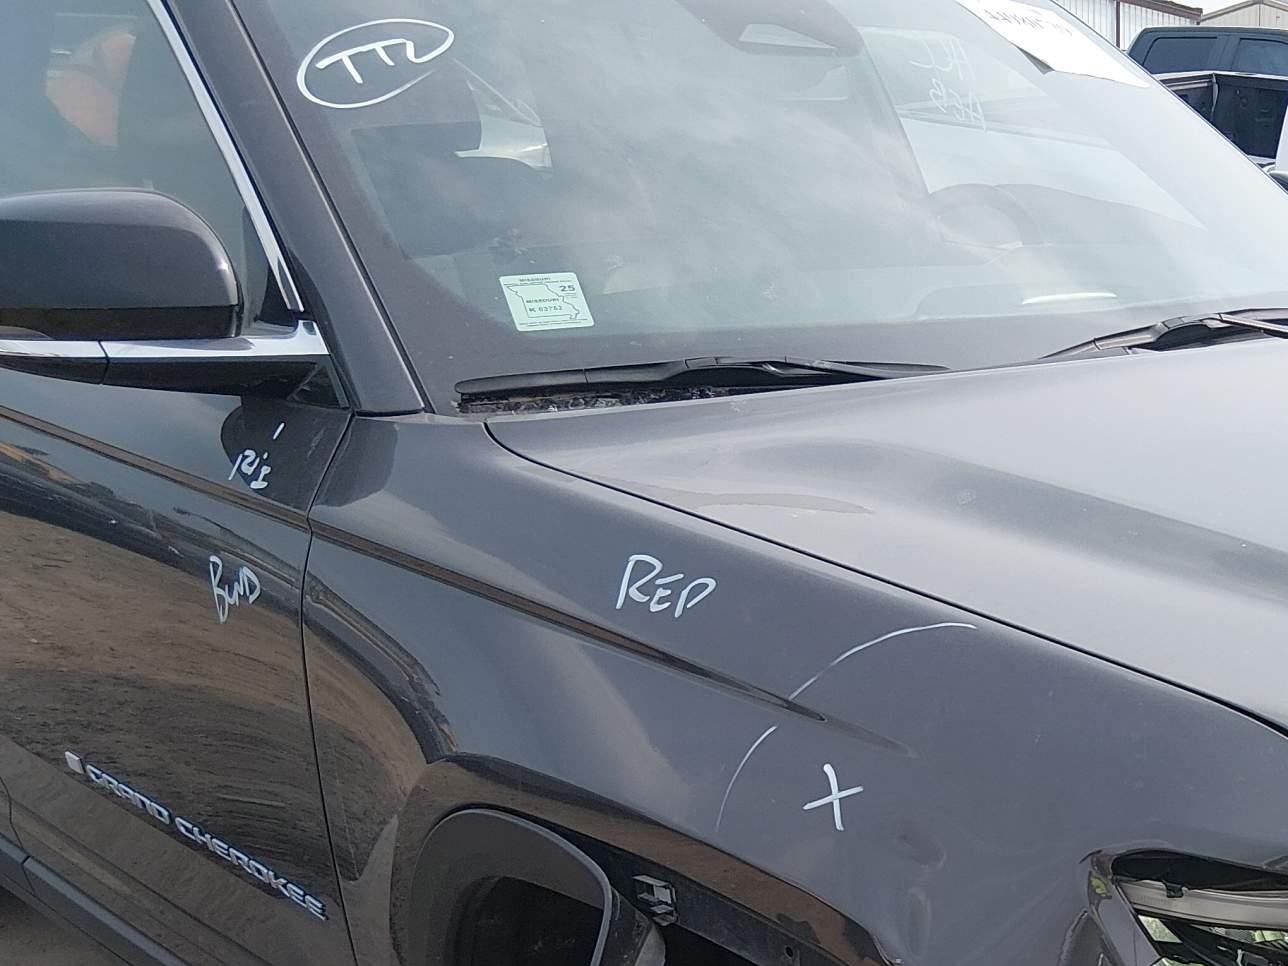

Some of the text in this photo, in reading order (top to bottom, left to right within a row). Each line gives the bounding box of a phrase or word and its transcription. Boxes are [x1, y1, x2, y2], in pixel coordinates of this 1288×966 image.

[559, 284, 576, 293] 25
[86, 764, 329, 921] GRAND CHEROKEE
